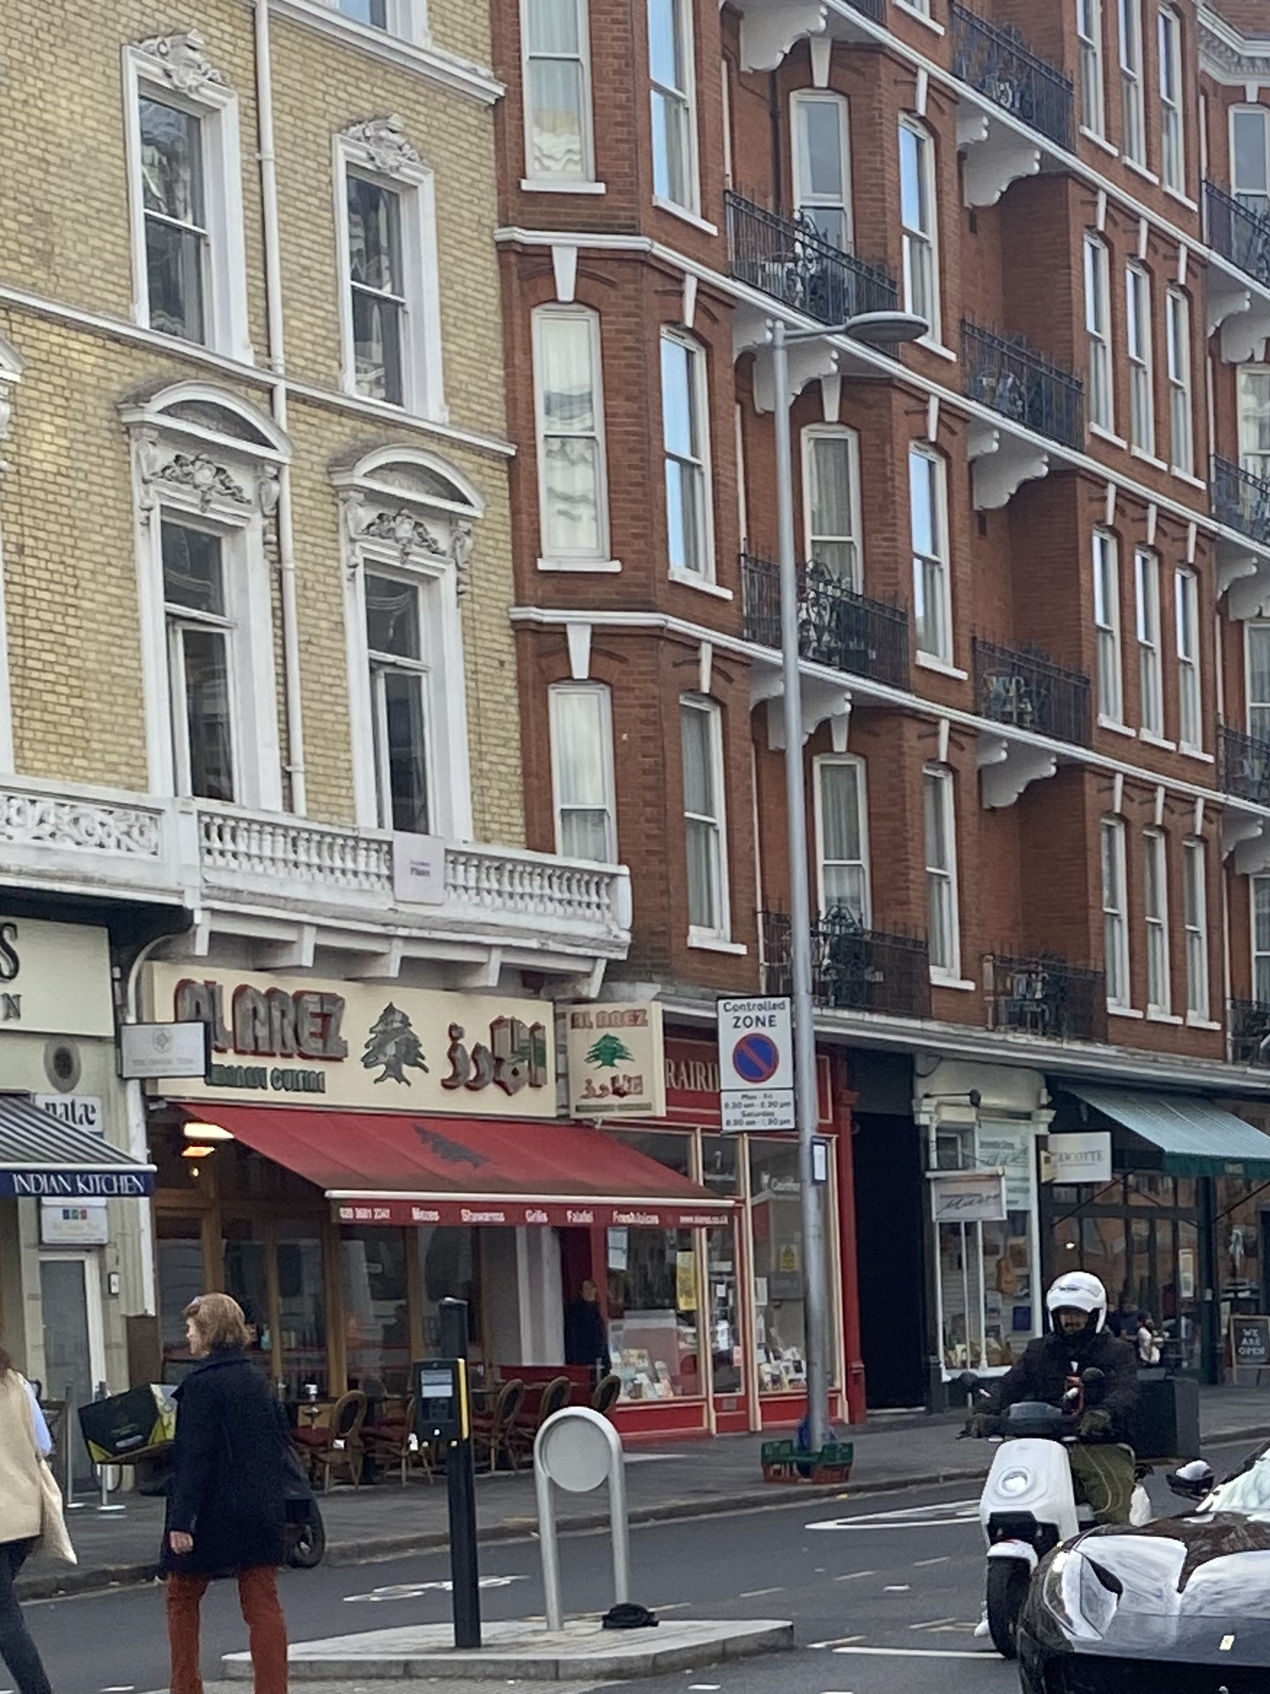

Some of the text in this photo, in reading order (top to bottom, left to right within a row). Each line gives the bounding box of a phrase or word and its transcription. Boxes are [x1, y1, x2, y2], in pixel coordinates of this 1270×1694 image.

[723, 1001, 786, 1012] Controlled
[733, 1015, 777, 1028] ZONE
[12, 1174, 145, 1194] INDIAN KITCHEN
[1242, 1329, 1259, 1337] WE
[1241, 1338, 1260, 1346] ARE
[1238, 1347, 1265, 1355] OPEN
